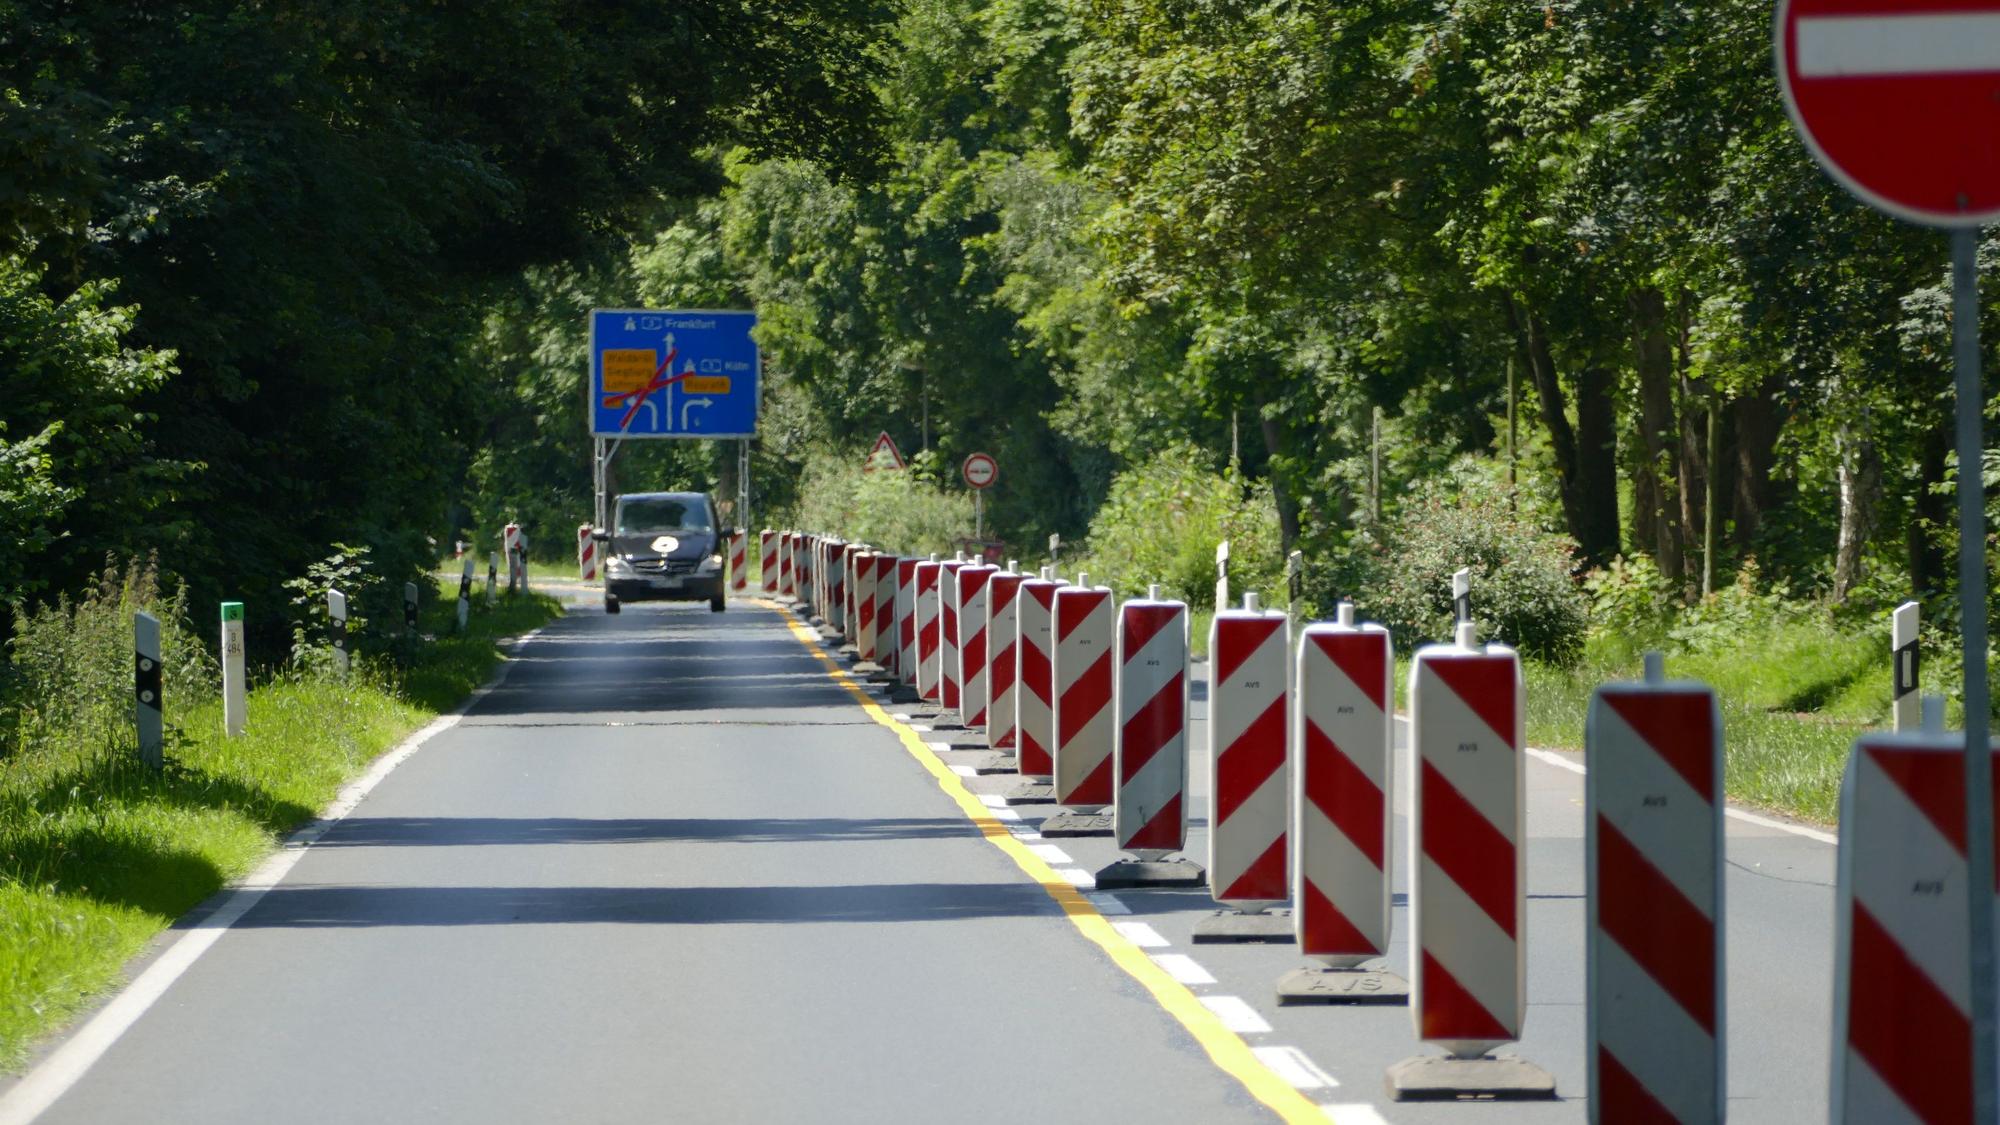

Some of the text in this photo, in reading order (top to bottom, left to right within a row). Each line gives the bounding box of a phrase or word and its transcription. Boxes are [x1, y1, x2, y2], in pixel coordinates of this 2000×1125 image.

[665, 318, 717, 329] Frankfurt
[1244, 681, 1261, 689] AVS
[1457, 742, 1479, 752] AVS
[1642, 795, 1668, 808] AVS
[1912, 881, 1944, 895] AVS
